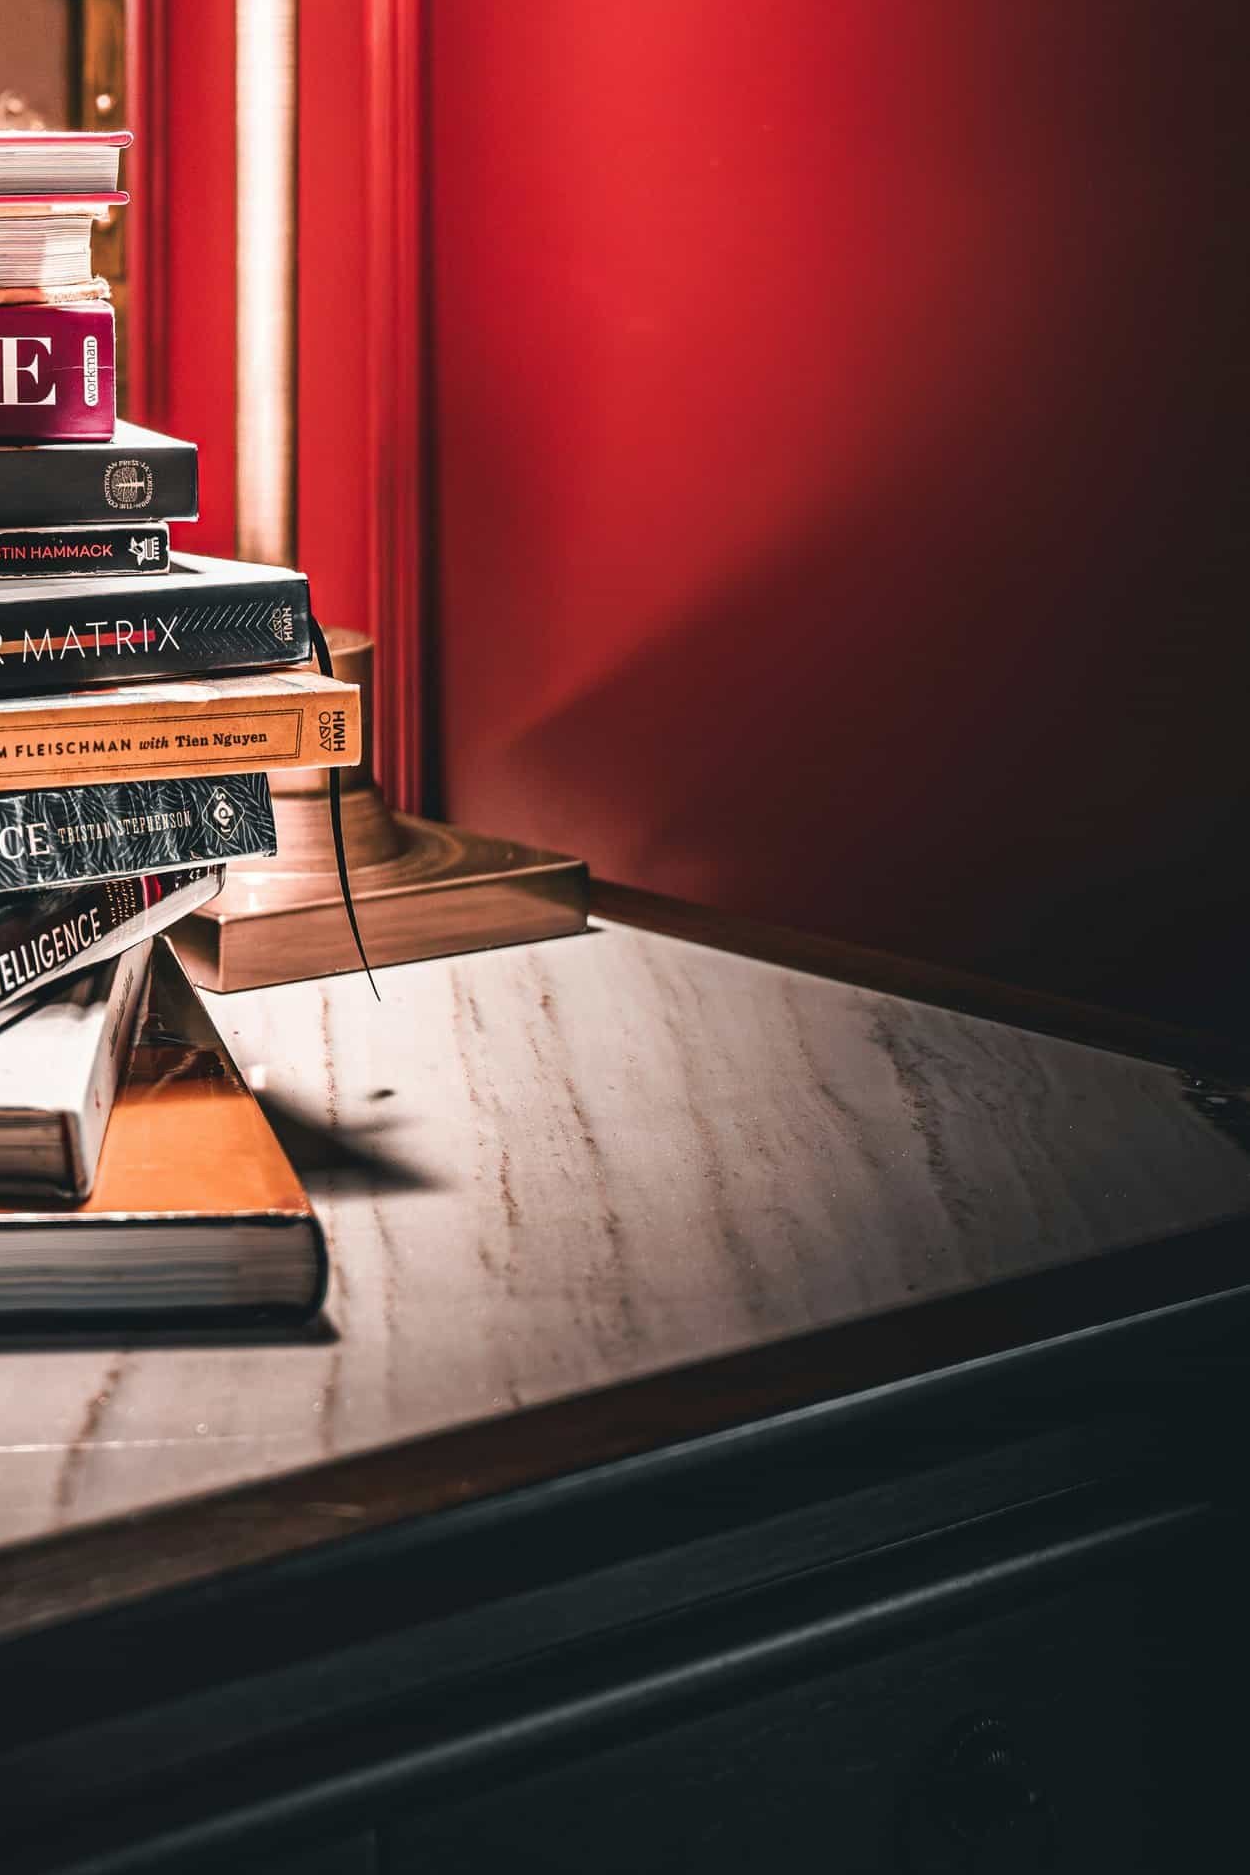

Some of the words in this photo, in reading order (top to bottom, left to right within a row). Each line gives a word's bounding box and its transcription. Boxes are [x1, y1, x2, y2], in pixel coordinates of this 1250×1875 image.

[86, 339, 98, 403] workman
[31, 543, 113, 559] HAMMACK
[23, 616, 180, 663] MATRIX
[282, 607, 294, 641] HMH
[15, 738, 132, 758] FLEISCHMAN
[138, 735, 170, 751] with
[175, 734, 209, 749] Tien
[213, 731, 268, 749] Nguyen
[332, 710, 346, 751] HMH
[57, 823, 111, 845] TRISTAN
[117, 810, 191, 836] STEPHENSON
